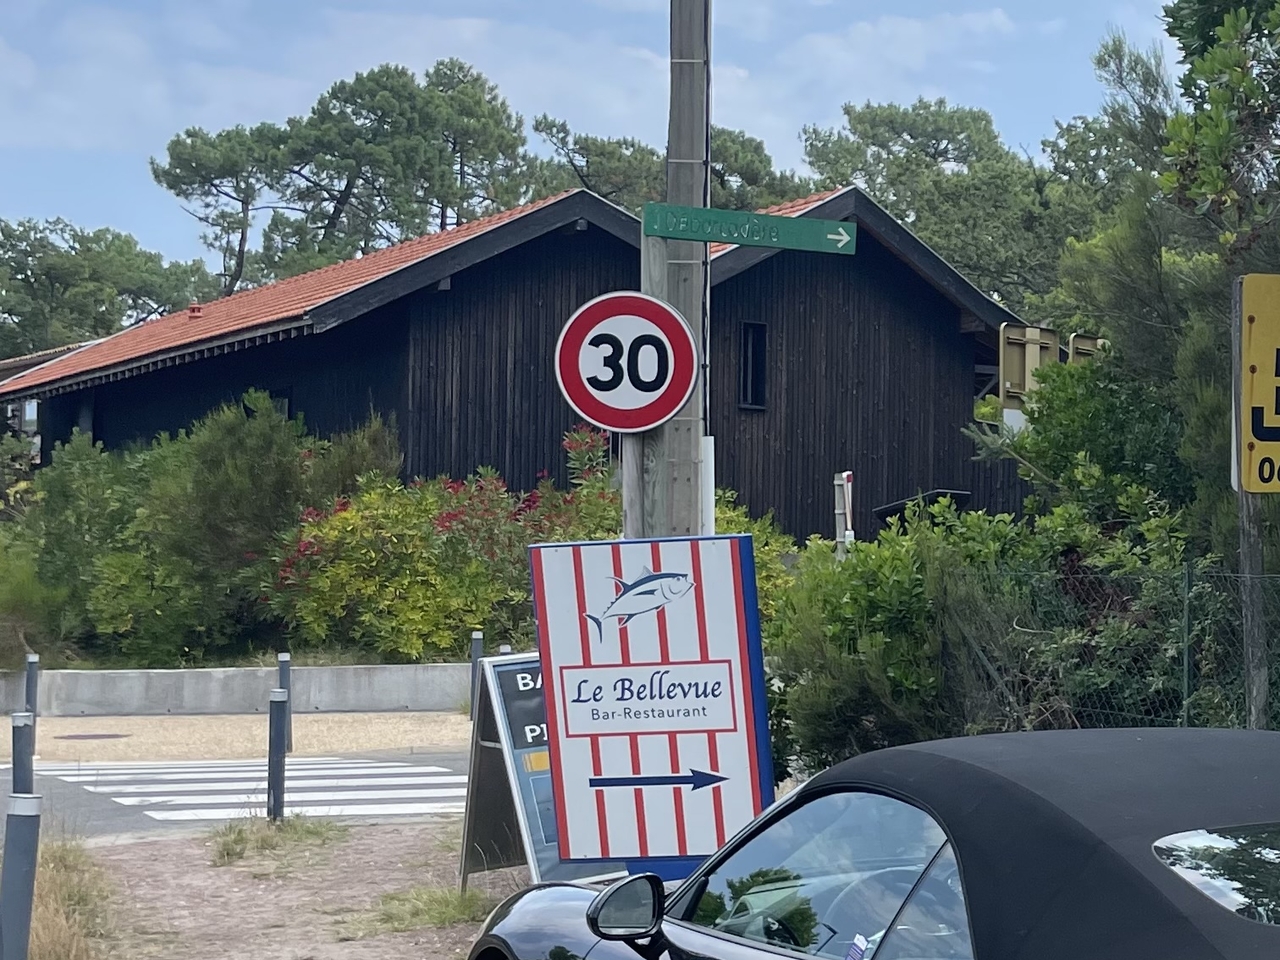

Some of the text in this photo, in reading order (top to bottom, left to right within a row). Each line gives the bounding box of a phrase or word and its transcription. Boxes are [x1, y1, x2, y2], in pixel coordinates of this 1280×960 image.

[586, 333, 669, 393] 30
[571, 670, 723, 703] Le Bellevue
[591, 705, 708, 721] Bar-Restaurant
